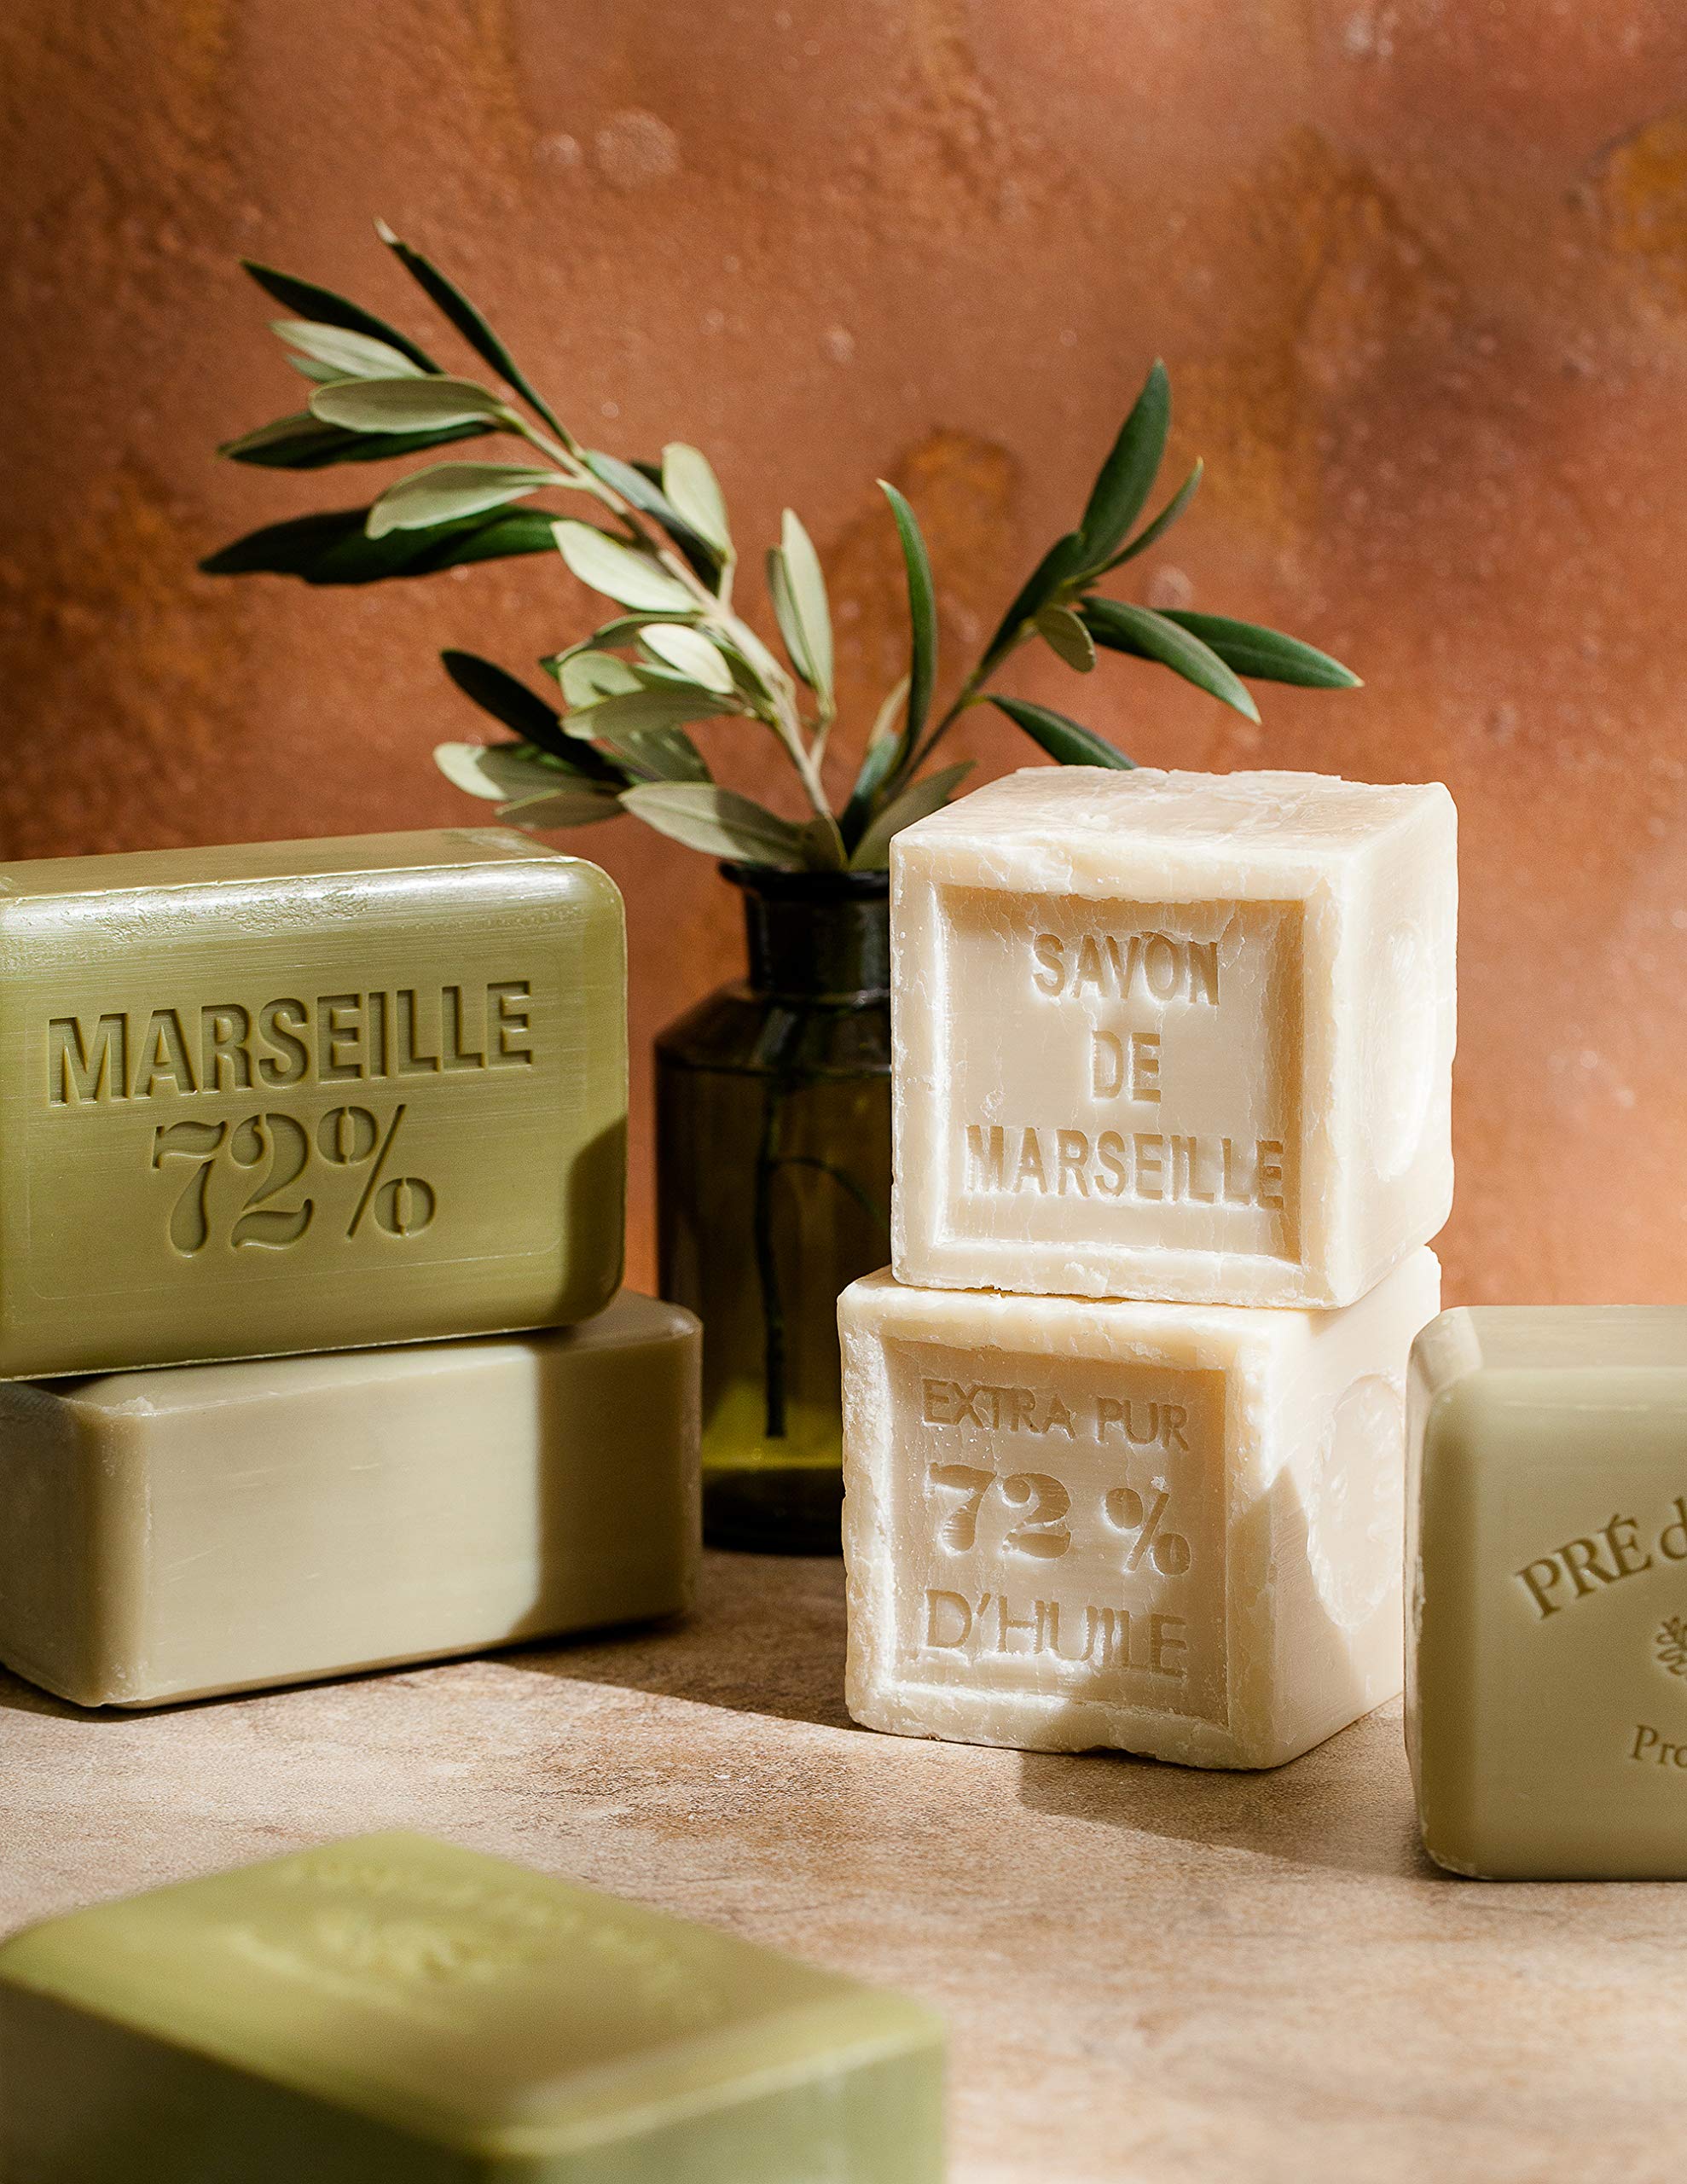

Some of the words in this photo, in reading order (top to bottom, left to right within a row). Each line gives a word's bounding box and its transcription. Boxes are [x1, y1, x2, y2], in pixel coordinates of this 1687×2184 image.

[1030, 931, 1220, 1006] SAVON
[49, 980, 533, 1107] MARSEILLE
[1092, 1030, 1162, 1104] DE
[151, 1104, 437, 1258] 72%
[965, 1124, 1284, 1210] MARSEILLE
[922, 1378, 1076, 1441] EXTRA
[1095, 1397, 1190, 1450] PUR
[925, 1461, 1073, 1560] 72
[1104, 1487, 1191, 1577] %
[1515, 1513, 1653, 1621] PRÉ
[924, 1589, 1188, 1679] D'HUILE
